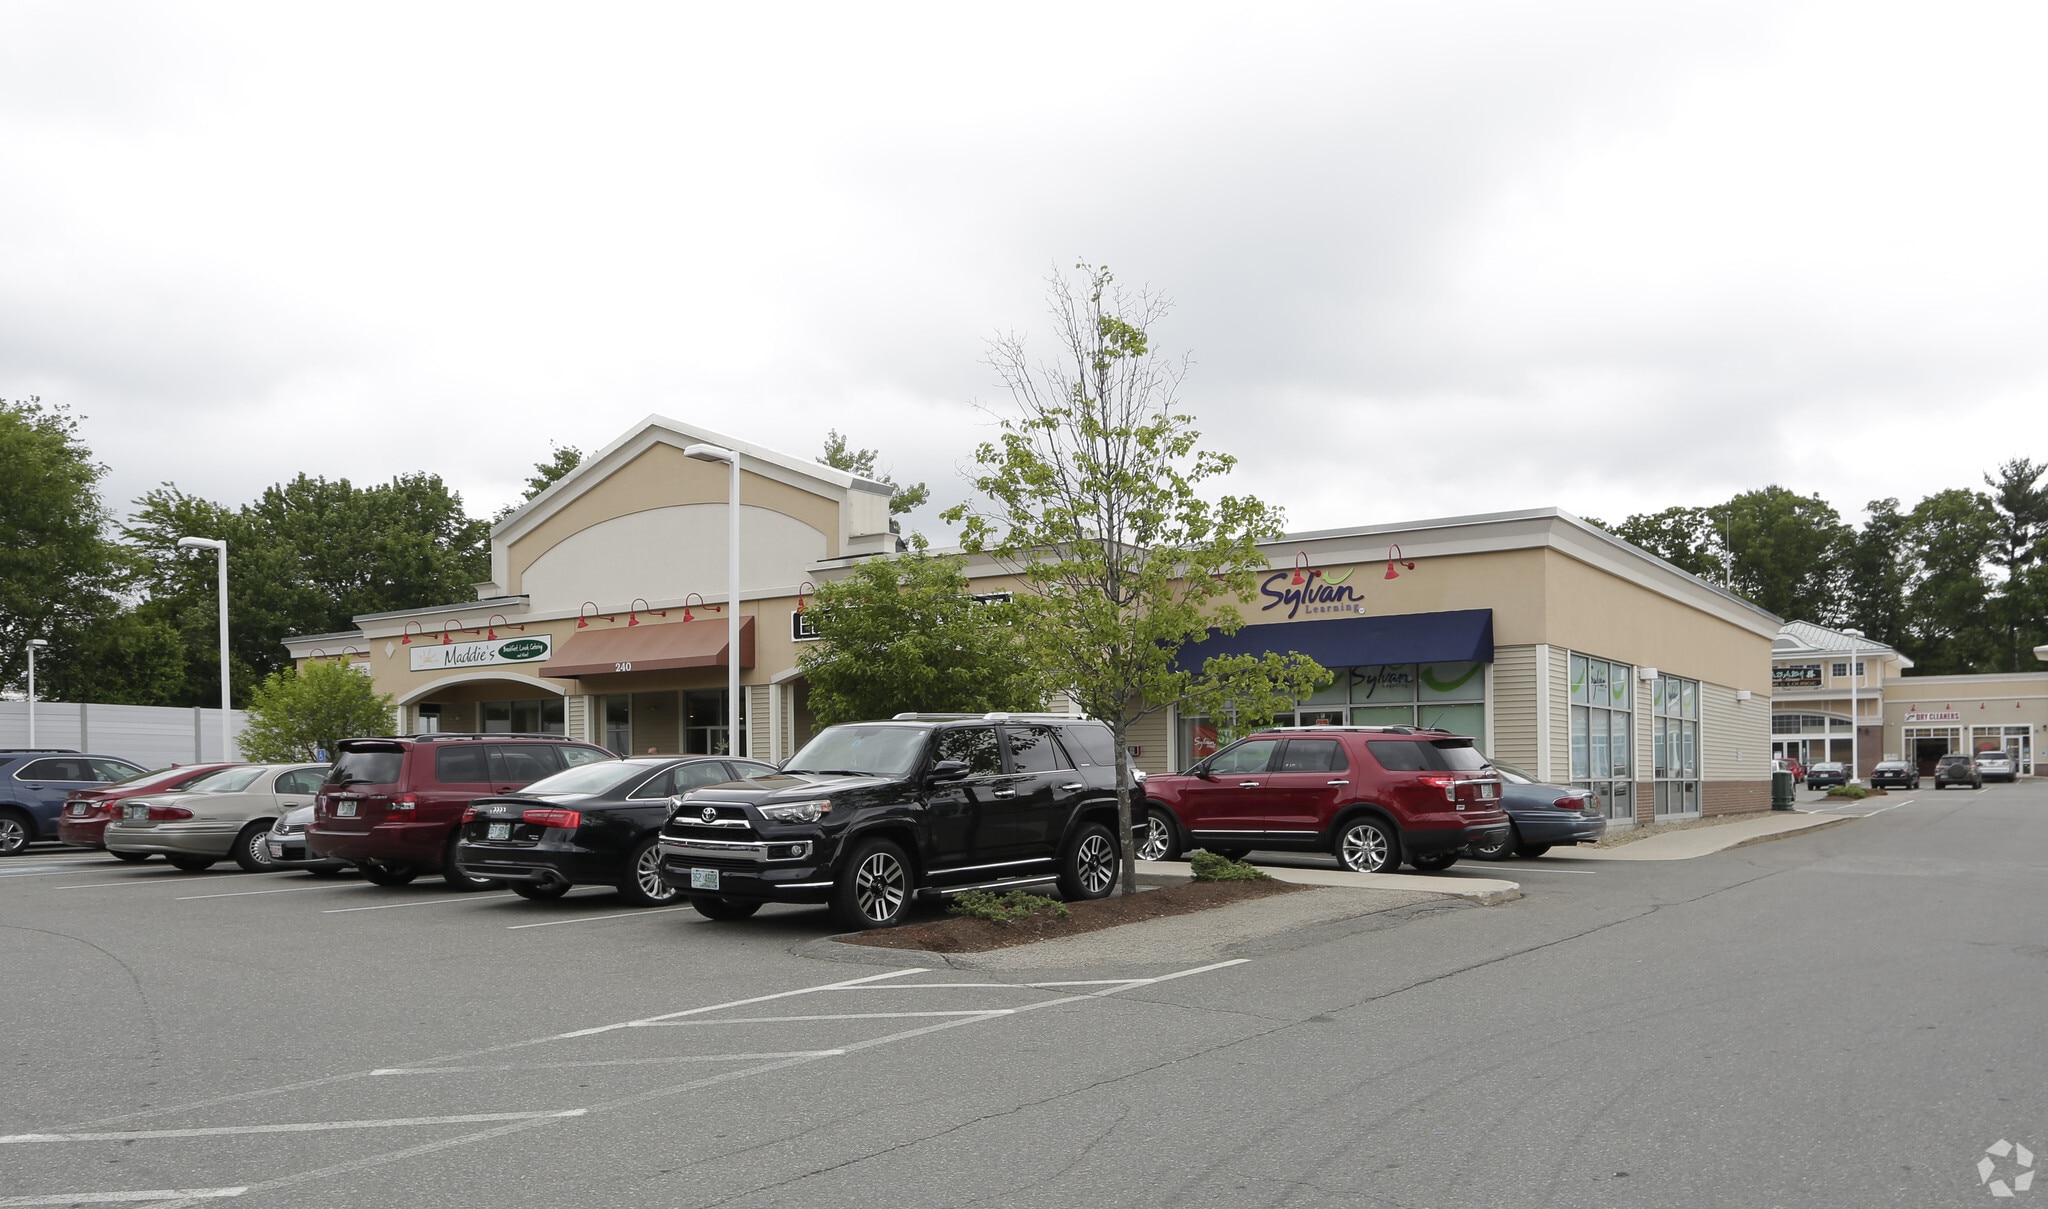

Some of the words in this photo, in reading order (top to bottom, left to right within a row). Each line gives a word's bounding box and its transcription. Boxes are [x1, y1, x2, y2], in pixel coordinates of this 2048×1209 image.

[1260, 571, 1365, 619] Sylvan
[1304, 602, 1360, 614] Learning
[444, 645, 496, 667] Maddie's
[615, 662, 632, 672] 240
[1351, 665, 1414, 699] Sylvan
[1915, 713, 1928, 721] DRY
[1929, 712, 1960, 720] CLEANERS
